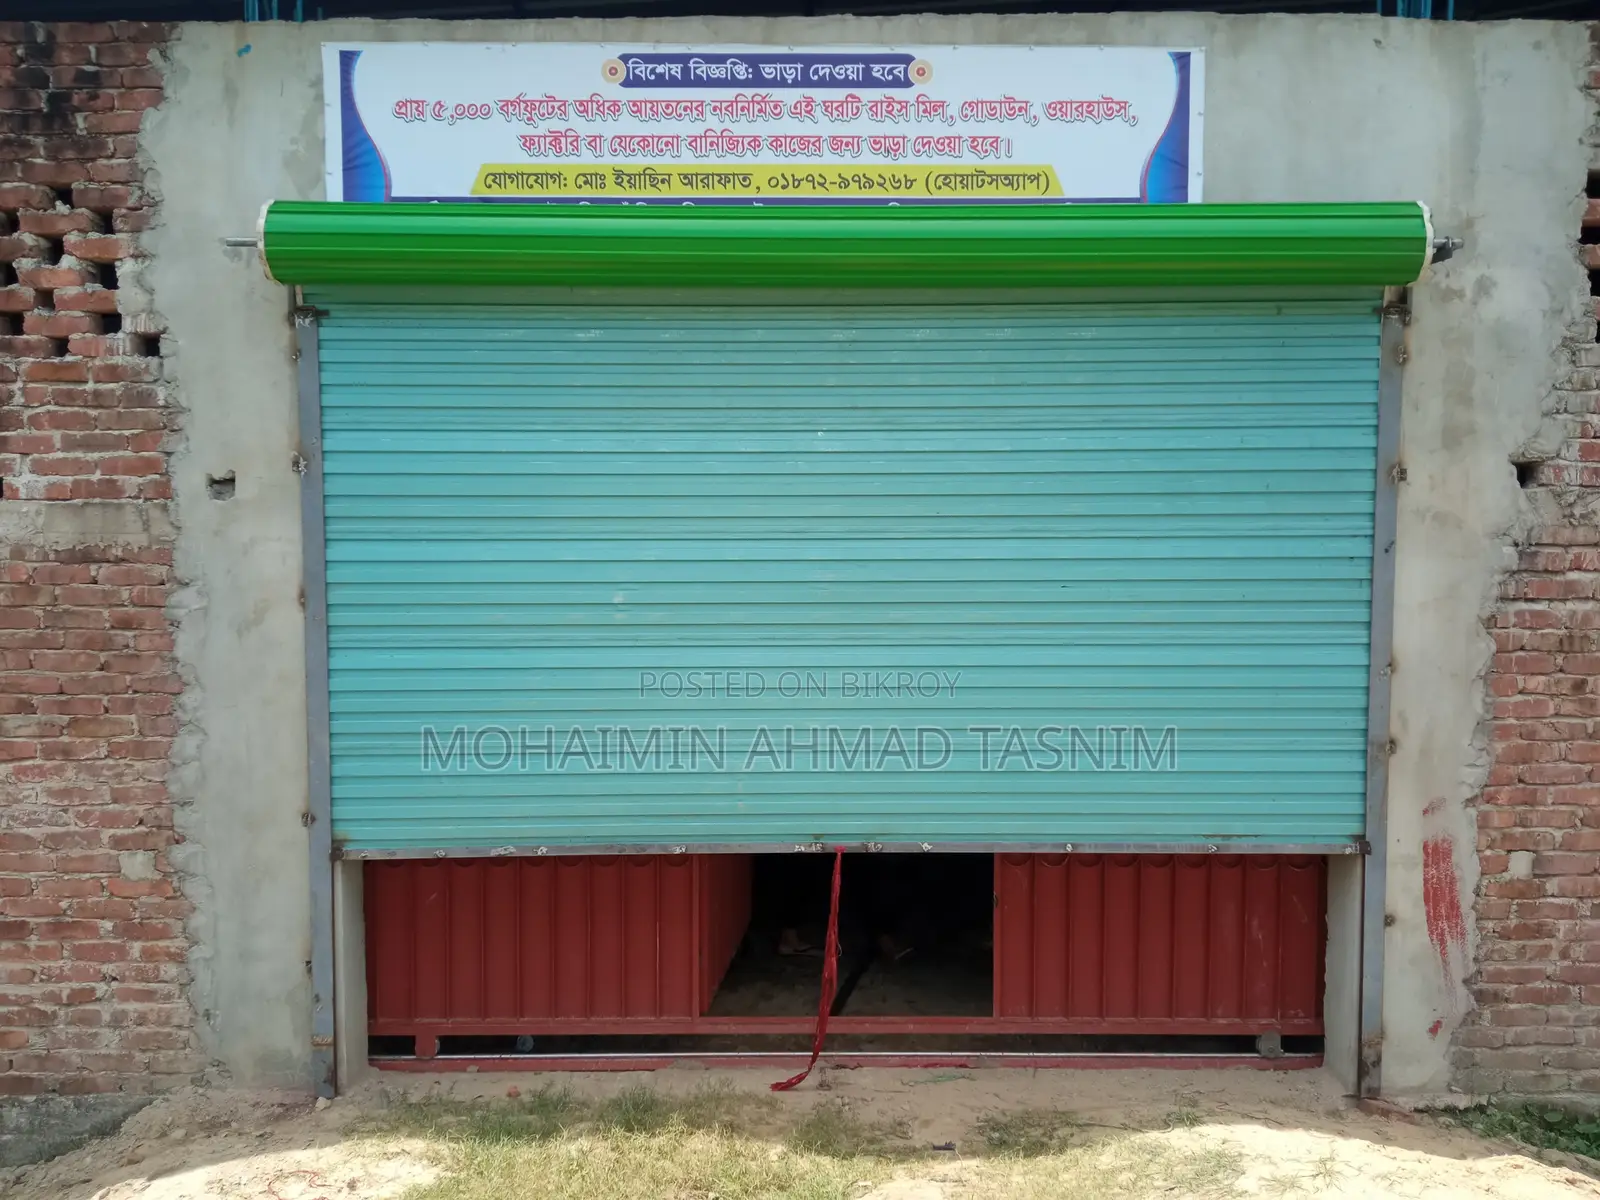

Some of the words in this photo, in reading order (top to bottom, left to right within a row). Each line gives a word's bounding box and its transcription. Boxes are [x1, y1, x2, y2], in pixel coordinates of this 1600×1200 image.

[627, 58, 683, 80] বিশেষ
[760, 63, 803, 82] ভাড়া
[809, 63, 864, 81] দেওয়া
[870, 63, 906, 81] হবে
[394, 98, 427, 122] প্রায়
[431, 99, 491, 125] ৫,০০০
[497, 93, 568, 127] বর্গফুটের
[571, 93, 622, 121] অধিক
[627, 98, 704, 122] আয়তনের
[710, 93, 783, 122] নবনির্মিত
[789, 94, 818, 123] এই
[821, 94, 862, 122] ঘরটি
[868, 94, 910, 122] রাইস
[914, 94, 956, 125] মিল,
[960, 95, 1039, 125] গোডাউন,
[1043, 94, 1138, 126] ওয়ারহাউস,
[583, 133, 606, 157] বা
[608, 133, 681, 157] যেকোনো
[766, 134, 824, 157] কাজের
[827, 134, 862, 157] জন্য
[868, 134, 908, 160] ভাড়া
[912, 134, 963, 158] দেওয়া
[483, 171, 568, 190] যোগাযোগ:
[574, 172, 606, 190] মোঃ
[613, 167, 672, 191] ইয়াছিন
[678, 172, 761, 194] আরাফাত,
[767, 172, 917, 190] ০১৮৭২-৯৭৯২৬৮
